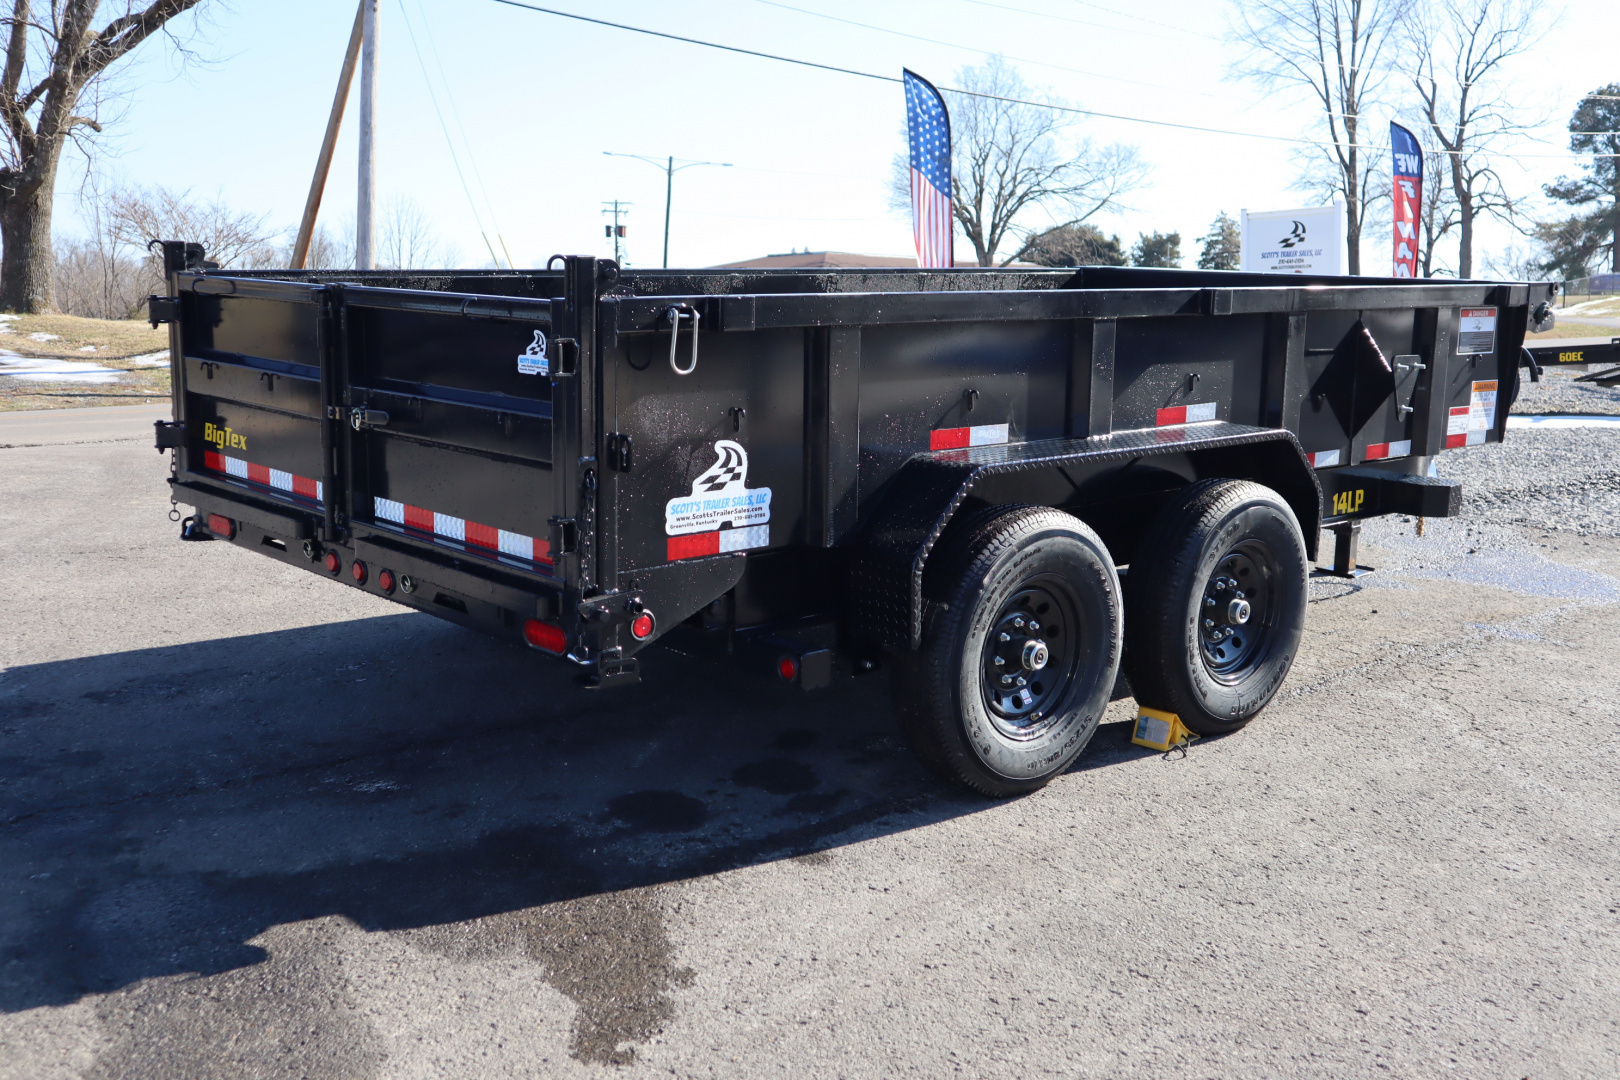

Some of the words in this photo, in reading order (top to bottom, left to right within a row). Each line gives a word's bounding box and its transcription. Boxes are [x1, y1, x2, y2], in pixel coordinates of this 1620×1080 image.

[1261, 251, 1280, 259] SCOTT'S
[1281, 250, 1298, 258] TRAILER
[1314, 248, 1323, 256] LLC
[1559, 351, 1584, 362] 60EC
[204, 422, 247, 450] BigTex
[670, 501, 701, 515] SCOTT'S
[703, 497, 730, 511] TRAILER
[731, 495, 754, 507] SALES,
[755, 493, 767, 504] LLC
[1332, 489, 1364, 516] 14LP
[676, 506, 763, 522] www.ScottsTrailerSales.com
